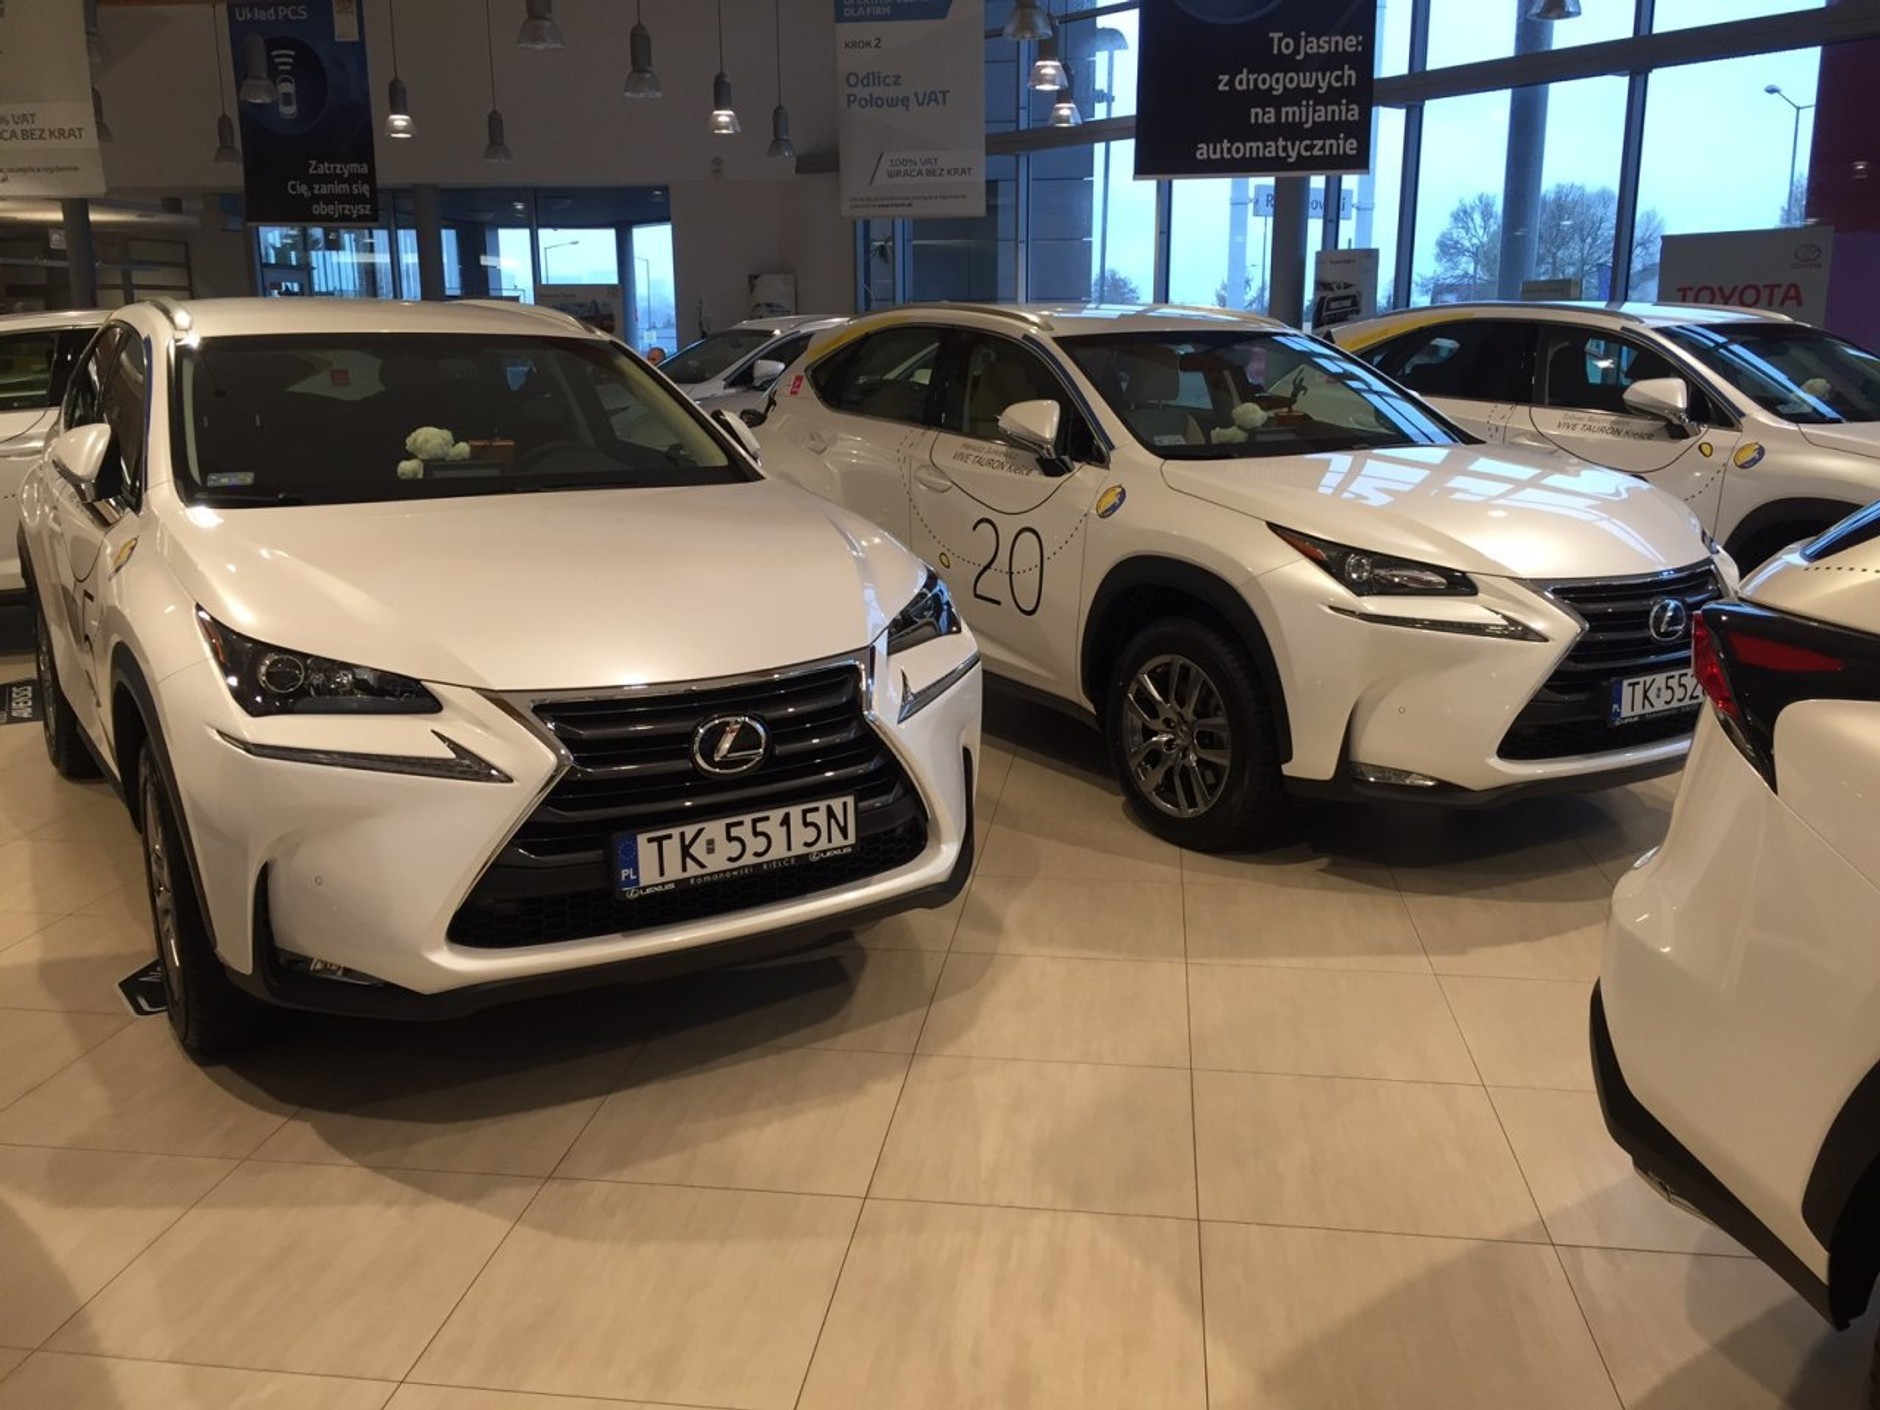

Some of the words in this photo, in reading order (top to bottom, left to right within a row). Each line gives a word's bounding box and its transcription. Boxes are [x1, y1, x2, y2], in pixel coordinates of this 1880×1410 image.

[278, 5, 307, 20] PCS
[844, 40, 872, 49] KROK
[874, 38, 882, 48] 2
[1269, 32, 1294, 54] To
[1295, 31, 1363, 60] jasne:
[846, 71, 903, 88] Odlicz
[1217, 75, 1230, 91] z
[1234, 64, 1357, 95] drogowych
[914, 89, 951, 107] VAT
[11, 113, 36, 125] VAT
[1250, 106, 1275, 124] na
[1280, 99, 1359, 128] mijania
[20, 128, 46, 140] BEZ
[48, 127, 84, 140] KRAT
[1195, 133, 1357, 163] automatycznie
[308, 160, 369, 178] Zatrzyma
[886, 169, 923, 179] WRACA
[925, 168, 945, 177] BEZ
[947, 167, 973, 177] KRAT
[313, 180, 350, 195] zanim
[352, 180, 370, 198] się
[312, 201, 371, 218] obejrzysz
[1676, 282, 1803, 308] TOYOTA
[972, 517, 1044, 616] 20
[1627, 678, 1657, 713] TK
[646, 826, 708, 878] TK
[724, 800, 849, 864] 5515N
[621, 867, 638, 882] PL
[690, 865, 754, 886] Romanowski
[763, 857, 796, 871] KIELCE
